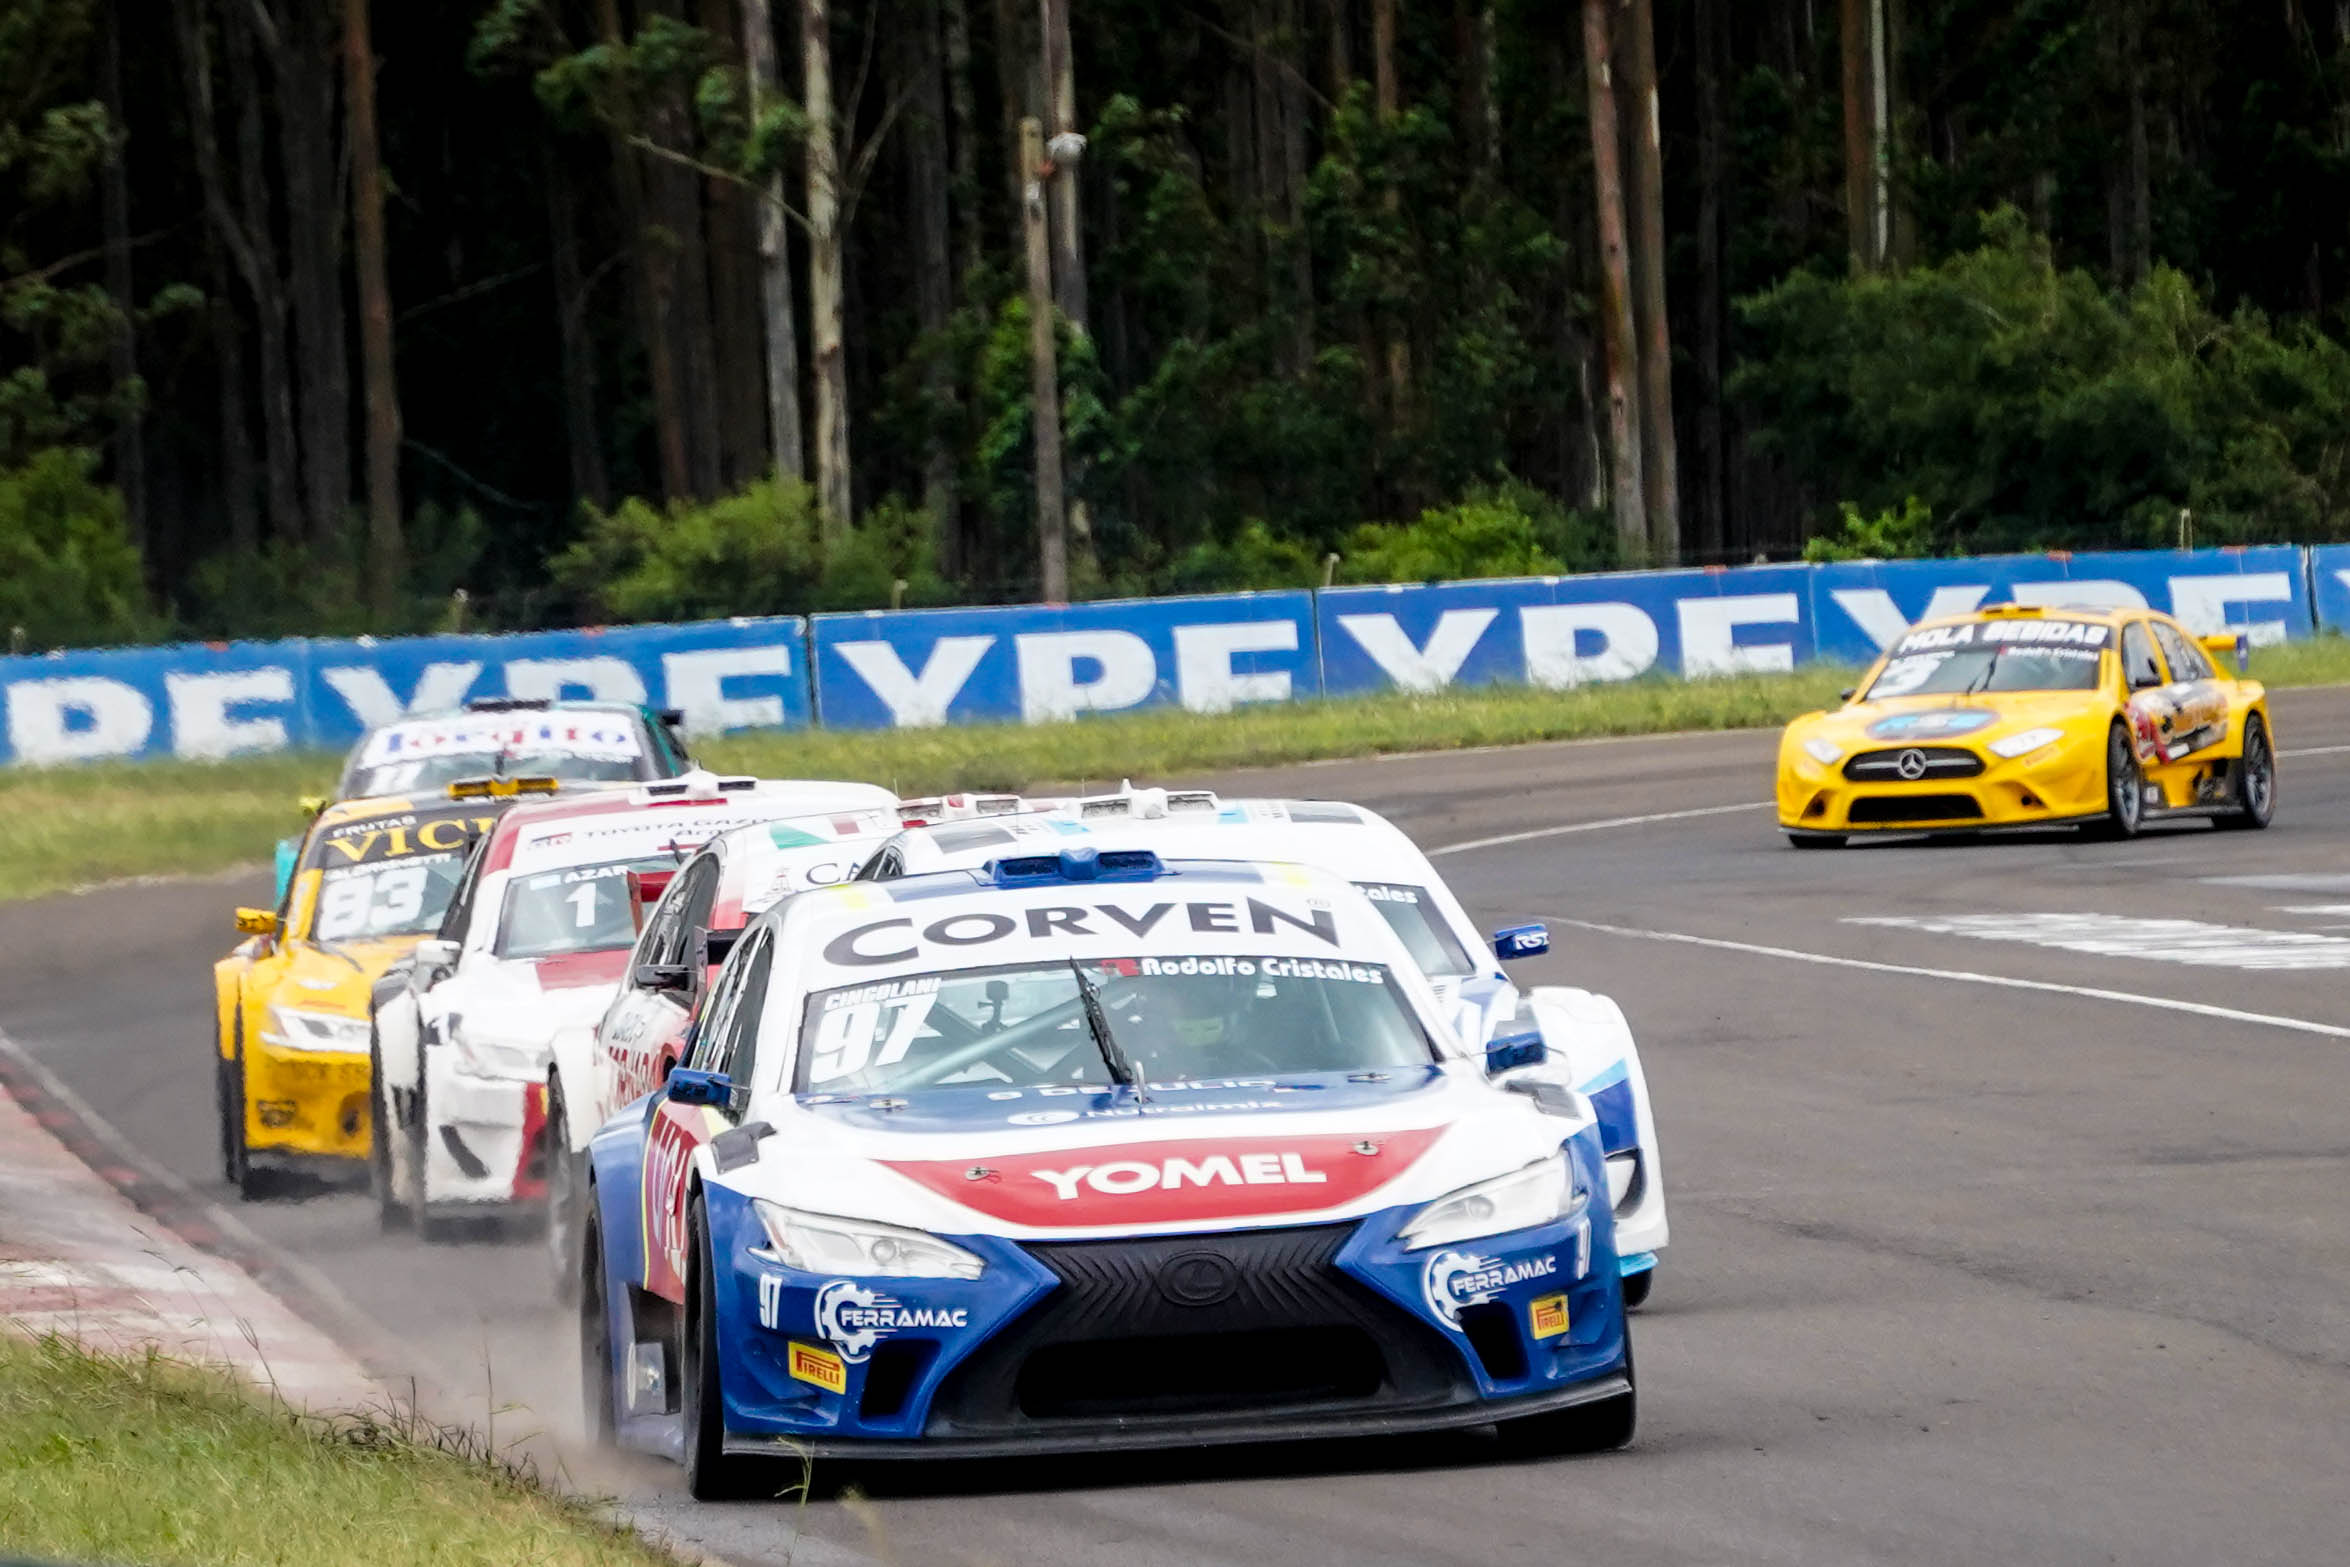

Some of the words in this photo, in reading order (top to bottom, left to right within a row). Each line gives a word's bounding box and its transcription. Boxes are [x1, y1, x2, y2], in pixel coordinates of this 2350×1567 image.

[1337, 592, 1799, 695] YPF
[1900, 623, 1974, 652] MOLA
[833, 619, 1299, 727] YPF
[332, 815, 418, 838] FRUTAS
[317, 866, 429, 940] 83
[566, 882, 598, 928] 1
[823, 896, 1340, 967] CORVEN
[1141, 957, 1256, 977] Rodolfo
[1261, 957, 1384, 985] Cristales
[824, 977, 942, 1011] CINGOLANI
[810, 992, 938, 1084] 97
[1031, 1152, 1328, 1201] YOMEL
[1452, 1256, 1557, 1297] FERRAMAC
[760, 1273, 783, 1330] 97
[840, 1307, 969, 1328] FERRAMAC
[1536, 1304, 1565, 1331] PIRELLI
[795, 1350, 841, 1386] PIRELLI
